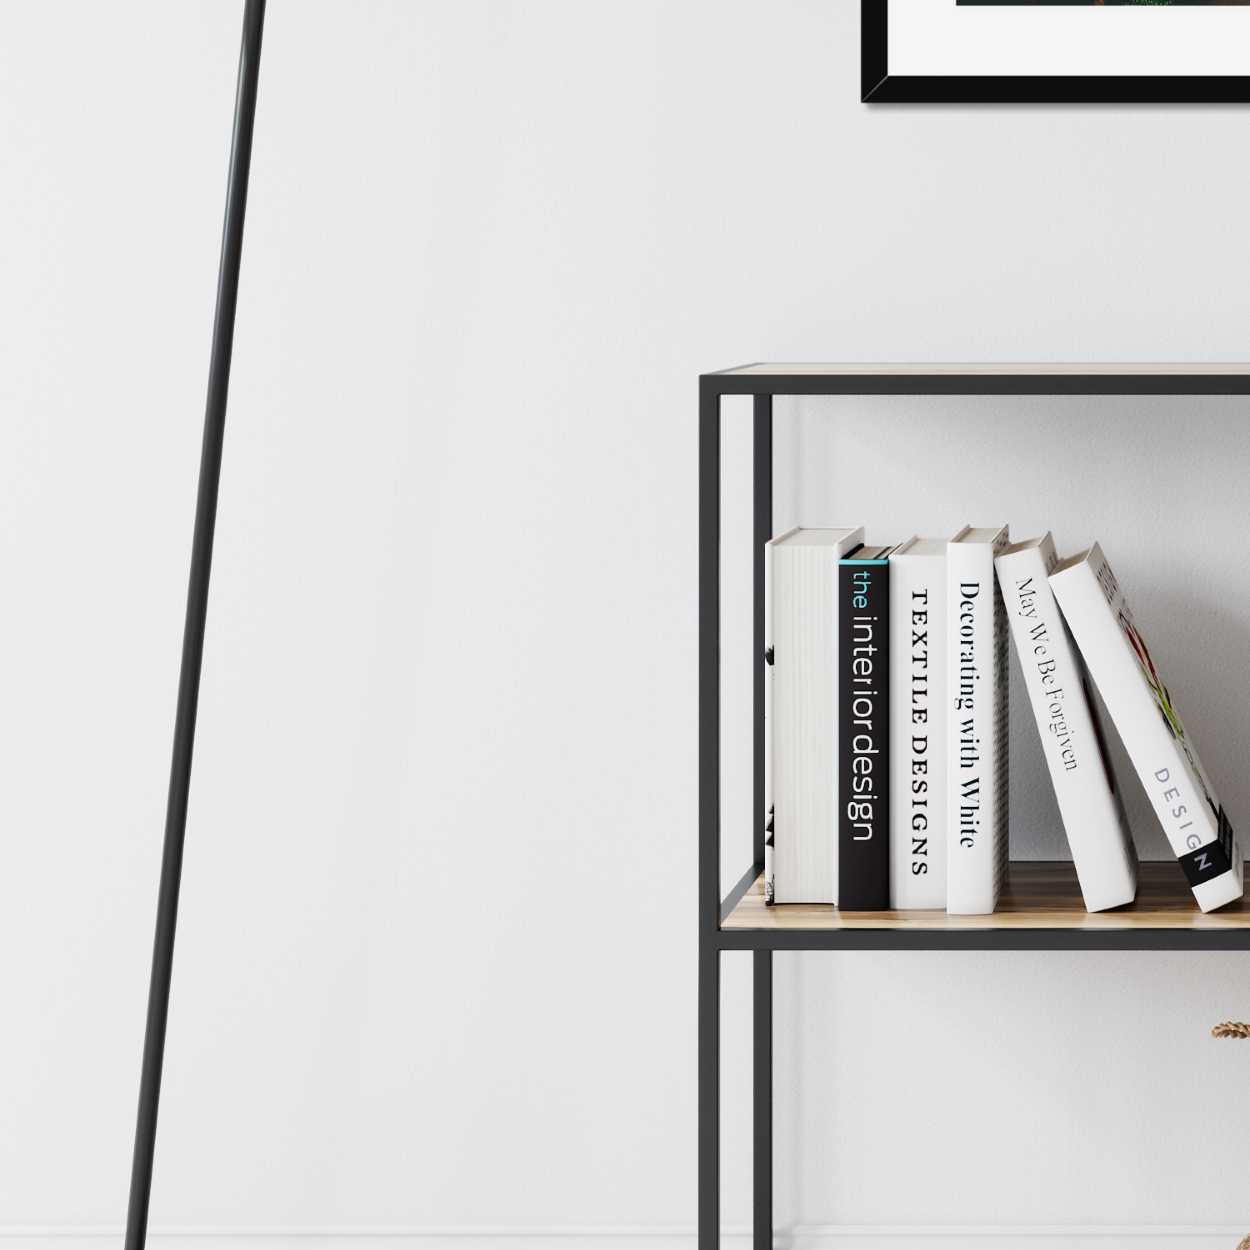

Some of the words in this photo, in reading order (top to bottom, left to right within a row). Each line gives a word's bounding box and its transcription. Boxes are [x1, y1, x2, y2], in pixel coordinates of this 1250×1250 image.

[852, 570, 871, 609] the
[1015, 576, 1038, 619] May
[911, 588, 928, 724] TEXTILE
[954, 582, 980, 711] Decorating
[1029, 622, 1050, 656] We
[1037, 658, 1057, 685] Be
[960, 718, 980, 769] with
[1045, 688, 1078, 771] Forgiven
[911, 735, 928, 876] DESIGNS
[960, 777, 980, 848] White
[1154, 766, 1213, 872] DESIGN
